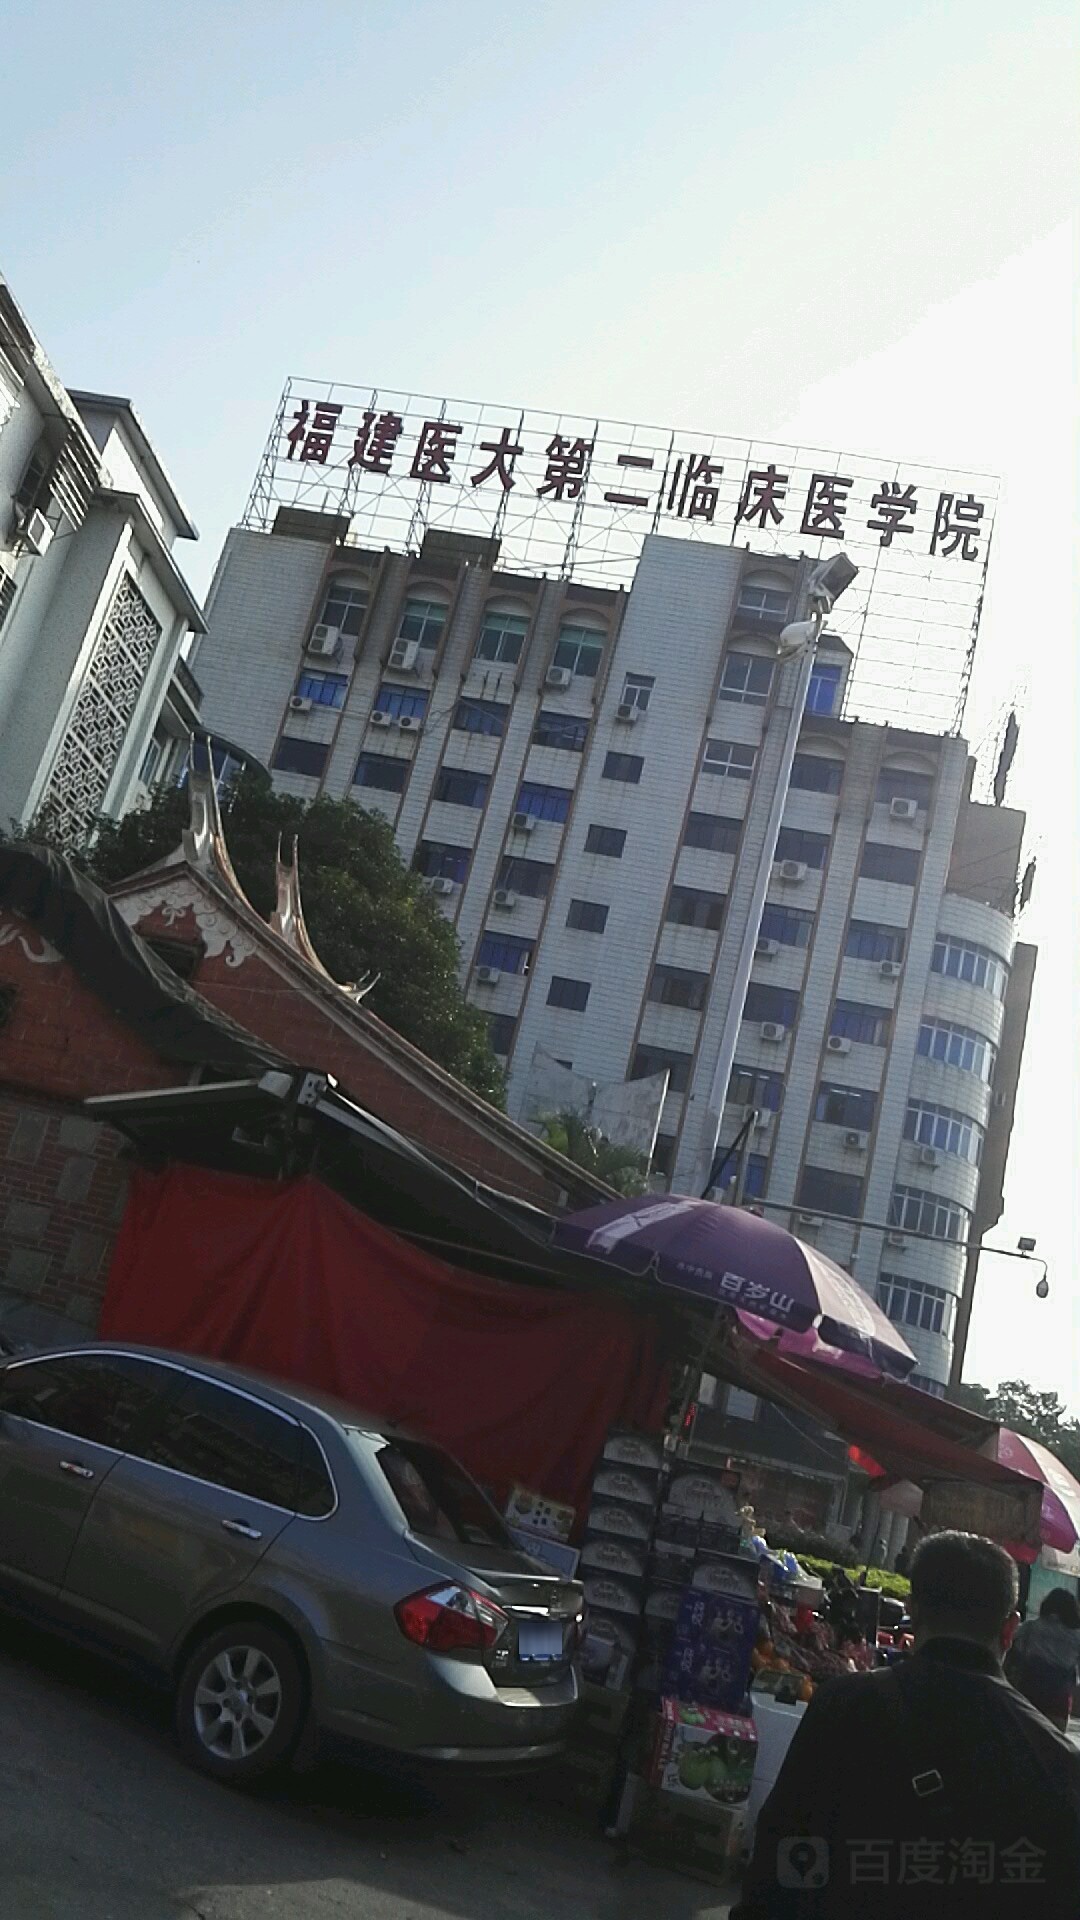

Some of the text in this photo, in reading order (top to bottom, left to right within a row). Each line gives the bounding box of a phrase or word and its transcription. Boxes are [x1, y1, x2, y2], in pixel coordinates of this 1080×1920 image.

[286, 398, 985, 561] 福建医大第二临床医学院
[720, 1271, 795, 1313] 百岁山
